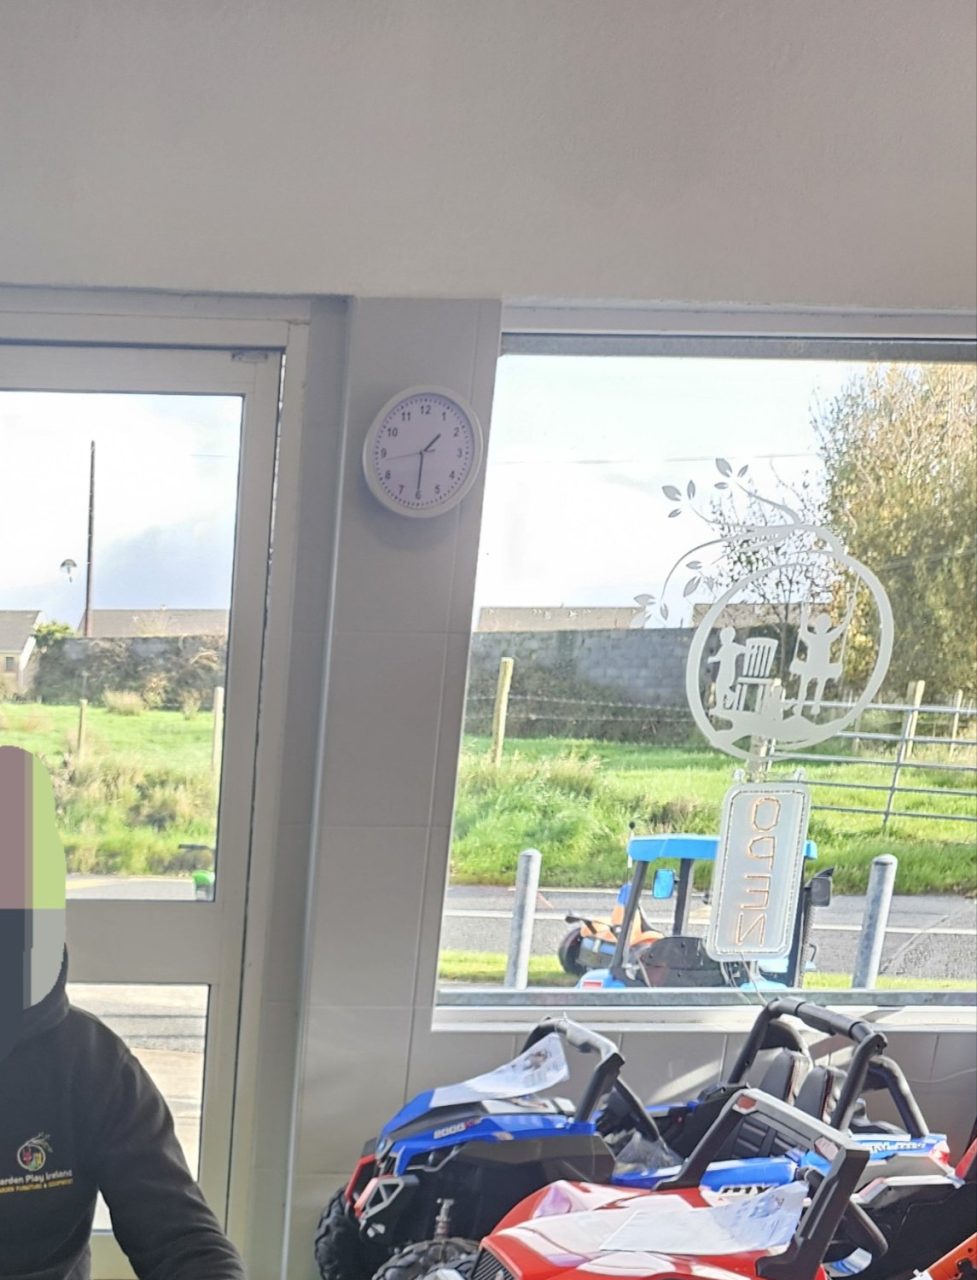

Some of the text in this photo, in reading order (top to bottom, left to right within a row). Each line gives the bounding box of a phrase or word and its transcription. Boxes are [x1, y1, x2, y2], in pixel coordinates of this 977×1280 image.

[420, 404, 431, 415] 12
[401, 411, 411, 421] 11
[442, 411, 447, 421] 1
[387, 427, 398, 437] 10
[453, 427, 460, 438] 2
[381, 448, 388, 458] 9
[457, 447, 463, 458] 3
[448, 470, 456, 480] 4
[434, 484, 441, 494] 5
[25, 1173, 45, 1184] Play
[46, 1169, 72, 1180] Ireland
